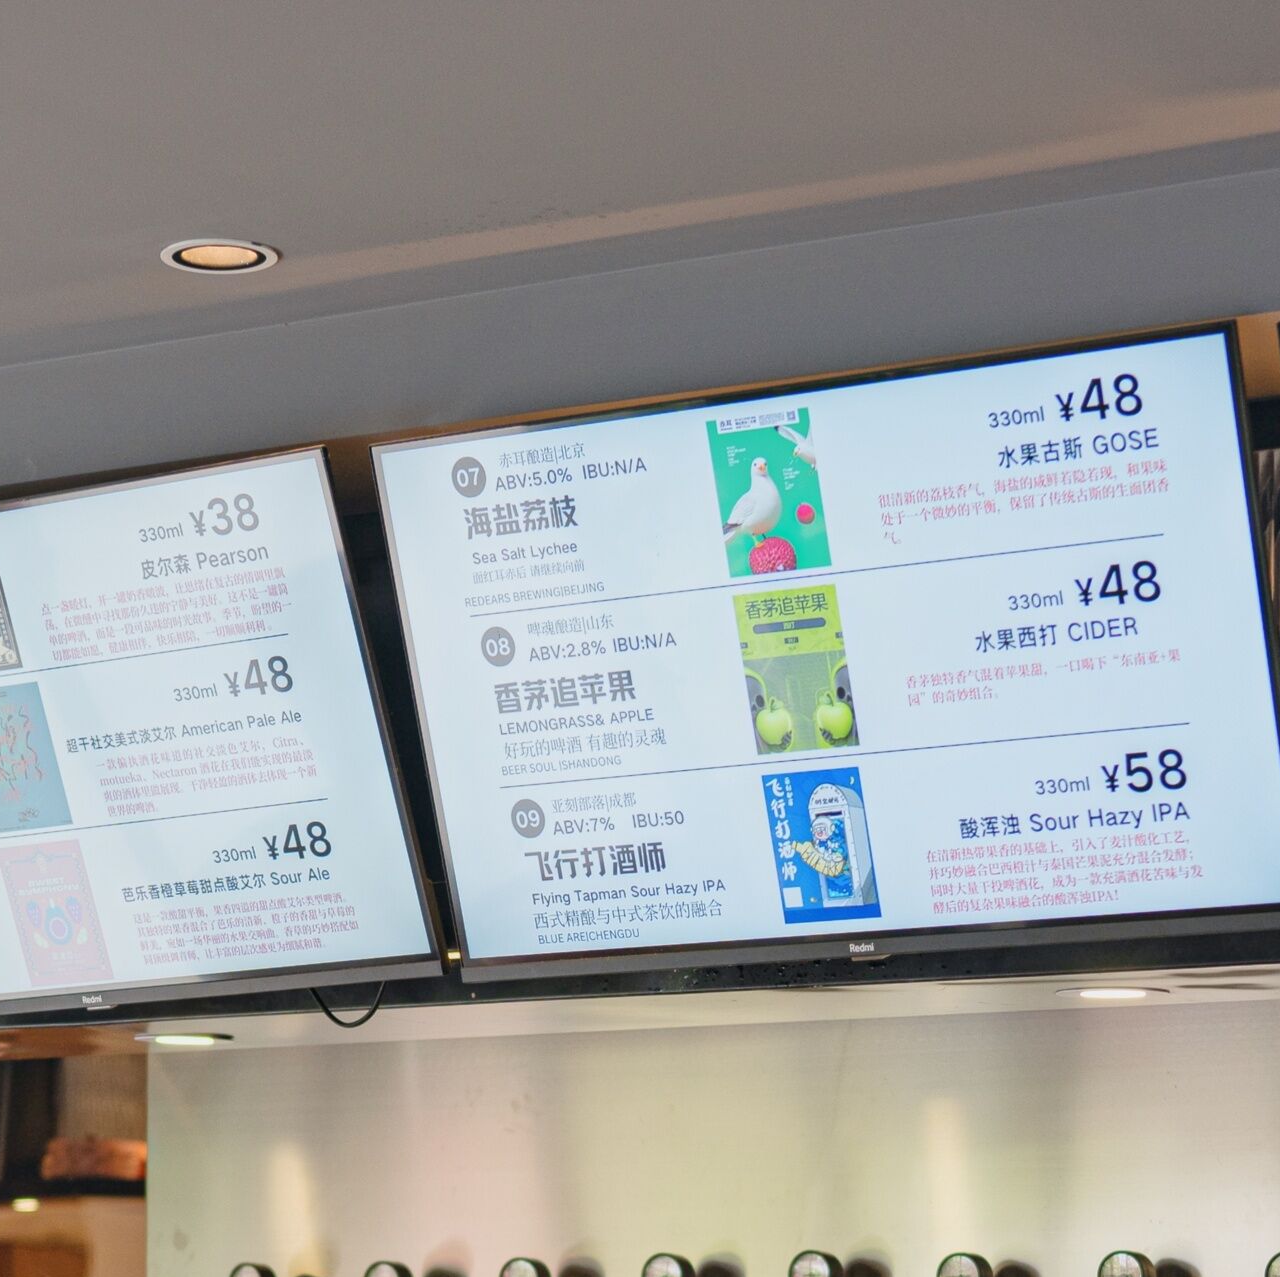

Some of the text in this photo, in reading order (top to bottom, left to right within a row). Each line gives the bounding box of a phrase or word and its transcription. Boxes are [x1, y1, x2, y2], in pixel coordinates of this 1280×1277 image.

[987, 373, 1143, 429] 330ml ¥48
[997, 427, 1160, 469] 水果古斯 GOSE
[456, 466, 481, 488] 07
[495, 457, 648, 492] ABV:5.0% IBU:N/A
[138, 492, 260, 543] 330ml ¥38
[462, 494, 579, 540] 海盐荔枝
[140, 544, 270, 580] 皮尔森 Pearson
[472, 542, 578, 565] Sea Salt Lychee
[464, 591, 511, 608] REDEARS
[1007, 560, 1162, 611] 330ml ¥48
[743, 591, 829, 619] 香茅追苹果
[484, 636, 511, 657] 08
[529, 631, 677, 663] ABV:2.8% IBU:N/A
[975, 616, 1139, 654] 水果西打 CIDER
[172, 655, 294, 703] 330ml ¥48
[492, 669, 637, 714] 香茅追苹果
[181, 709, 302, 738] American Pale Ale
[498, 707, 655, 736] LEMONGRASS& APPLE
[504, 727, 667, 760] 好玩的啤酒 有趣的灵魂
[501, 761, 555, 776] BEER SOUL
[1034, 748, 1188, 796] 330ml ¥58
[514, 808, 540, 829] 09
[553, 810, 685, 836] ABV:7% IBU:50
[958, 801, 1190, 840] 酸浑浊 Sour Hazy IPA
[212, 820, 332, 864] 330ml ¥48
[269, 867, 331, 886] Sour Ale
[523, 839, 668, 883] 飞行打酒师
[531, 878, 726, 907] Flying Tapman Sour Hazy IPA
[532, 898, 724, 930] 西式精酿与中式茶饮的融合
[537, 932, 564, 945] BLUE
[849, 943, 874, 953] Redmi
